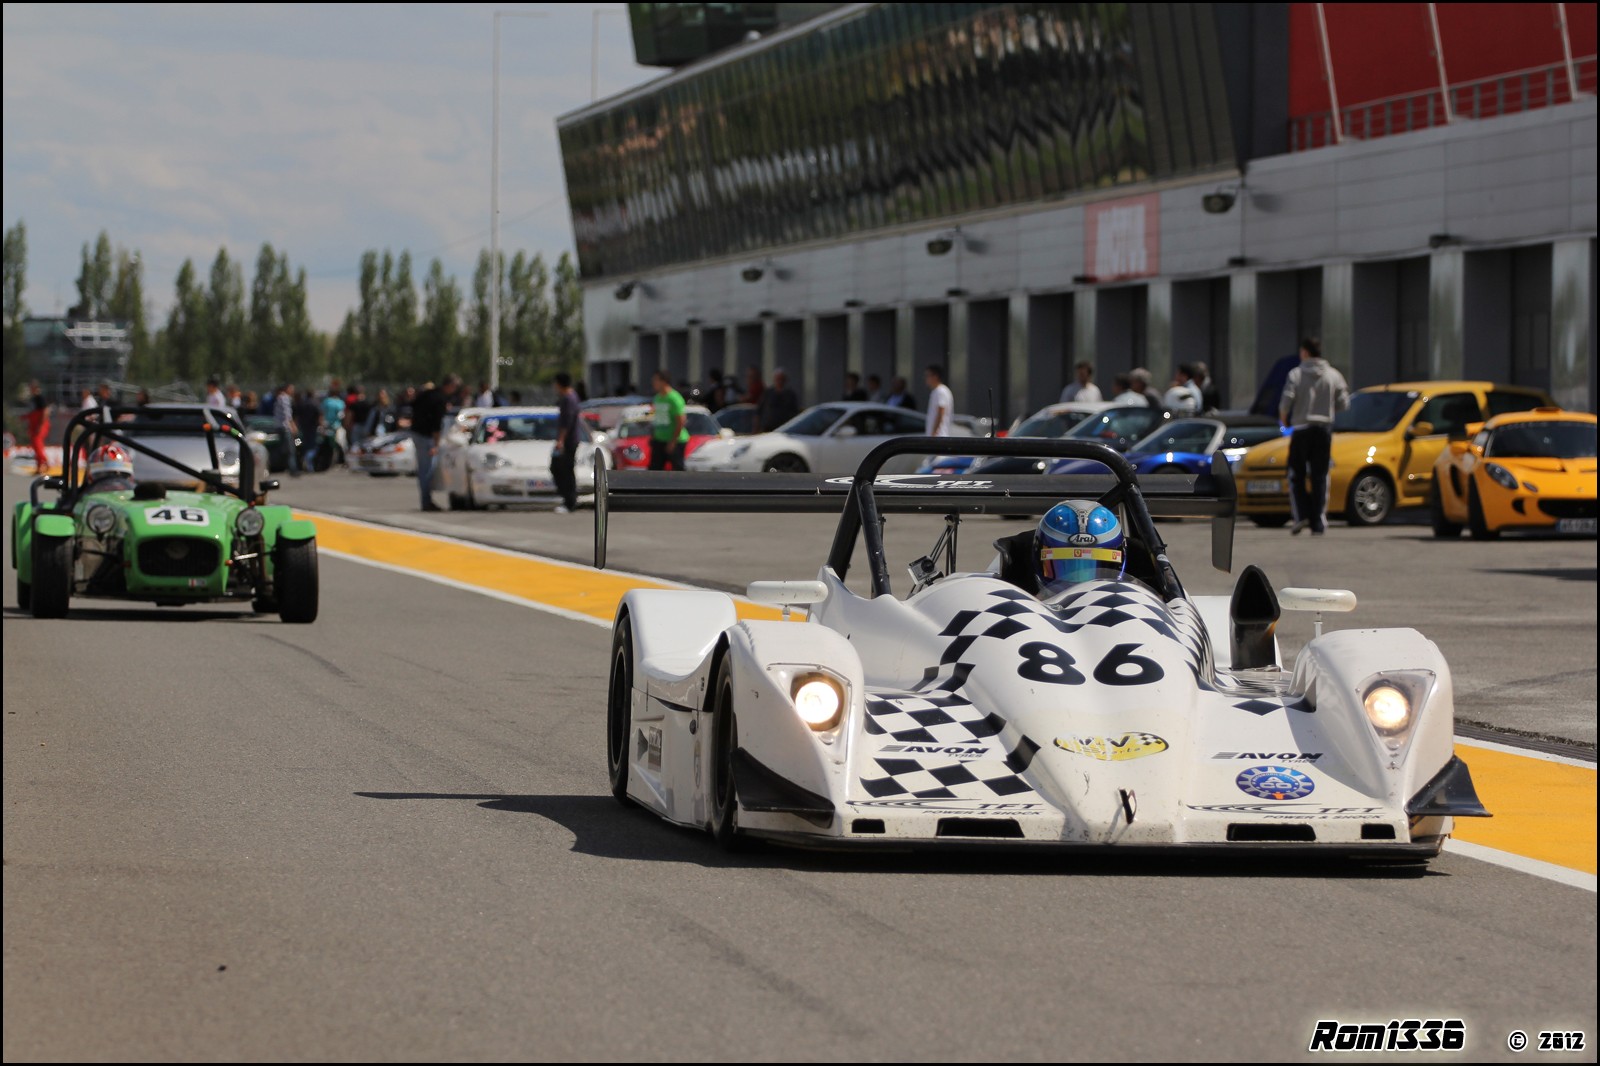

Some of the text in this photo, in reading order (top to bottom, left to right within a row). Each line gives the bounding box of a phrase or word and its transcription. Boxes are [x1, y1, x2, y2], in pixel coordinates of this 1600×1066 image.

[151, 508, 204, 522] 46
[1072, 533, 1094, 544] Arai
[1016, 641, 1165, 686] 86
[903, 745, 991, 753] AVON
[1236, 752, 1324, 760] AVON
